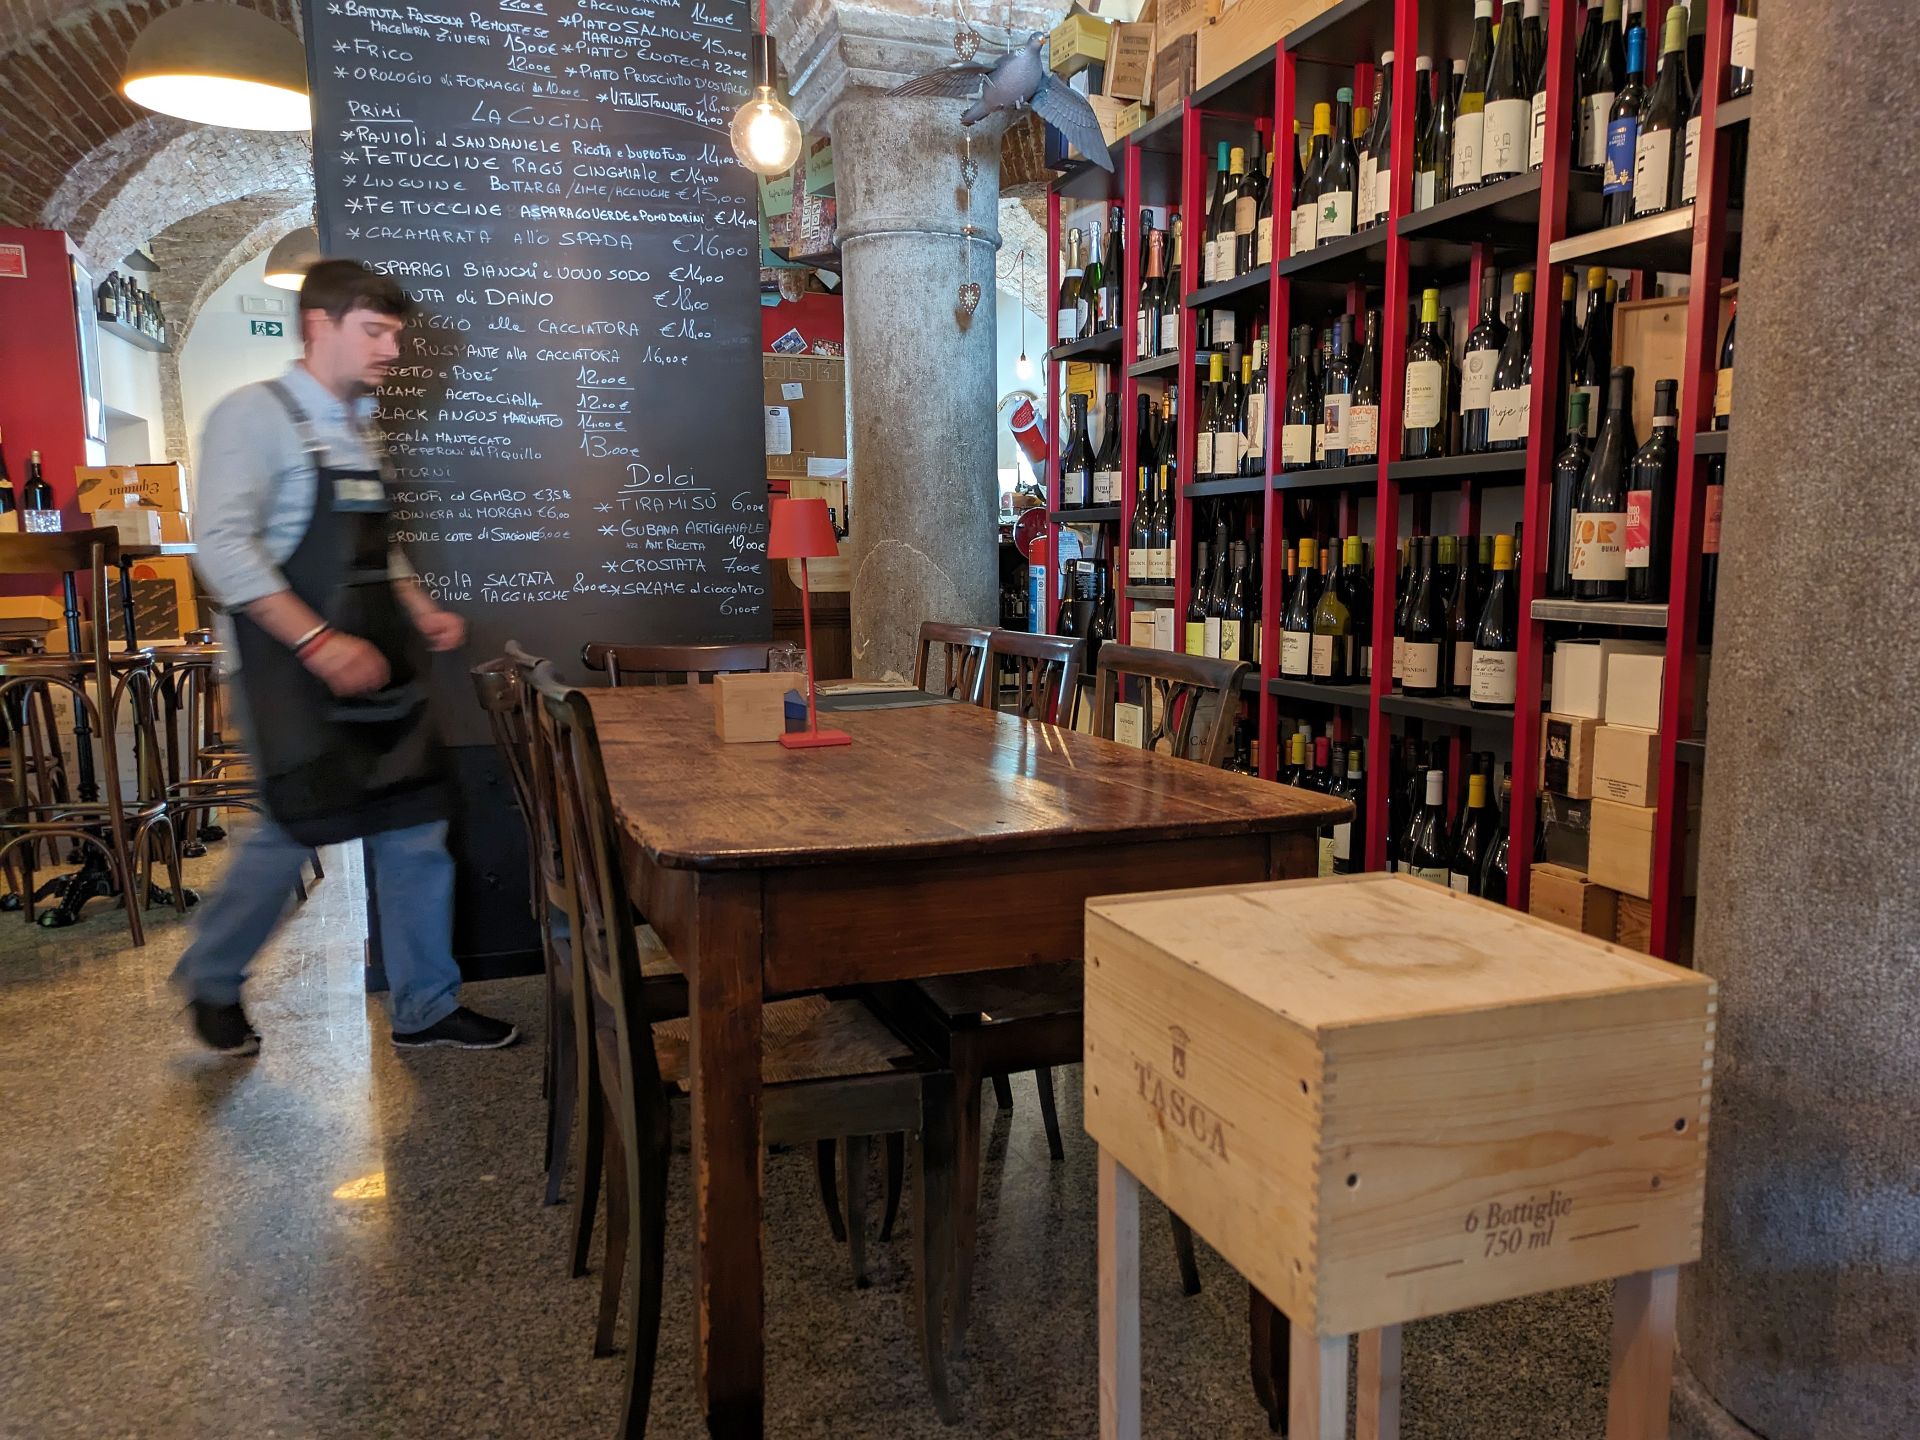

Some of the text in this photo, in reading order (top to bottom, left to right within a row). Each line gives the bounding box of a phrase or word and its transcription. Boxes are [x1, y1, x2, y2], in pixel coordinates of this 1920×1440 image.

[361, 145, 500, 170] FETTUCCINE
[362, 174, 468, 192] LINGUINE
[364, 195, 503, 217] FETTUCCINE
[558, 231, 633, 250] SPADA
[1133, 1061, 1230, 1165] TASCA
[1464, 1193, 1573, 1234] 6 Bottiglie
[1483, 1222, 1554, 1259] 750 ml
